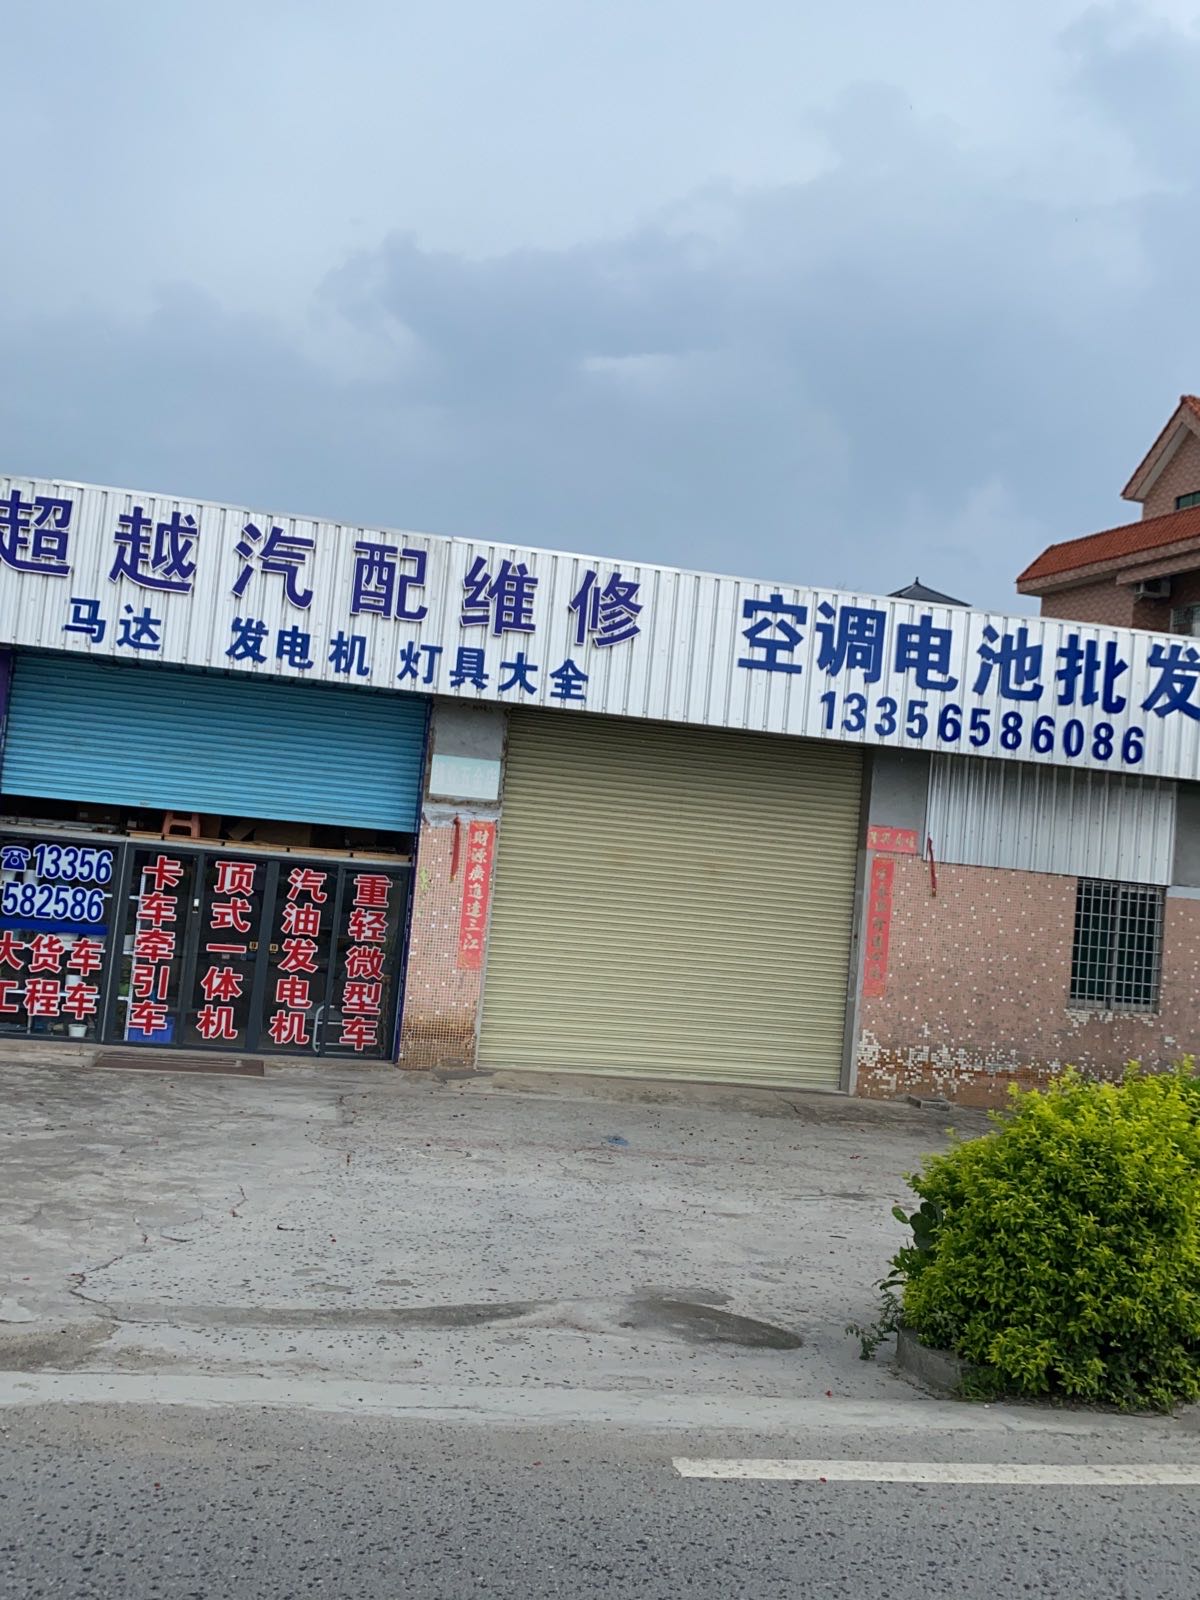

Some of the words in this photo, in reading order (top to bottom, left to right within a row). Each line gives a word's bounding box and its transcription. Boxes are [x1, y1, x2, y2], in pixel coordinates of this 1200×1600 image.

[0, 489, 643, 648] 超越汽配维修
[63, 597, 162, 652] 马达
[225, 616, 370, 677] 发电机
[397, 640, 589, 701] 灯具大全
[738, 594, 1200, 720] 空调电池批发
[821, 690, 1145, 765] 13356586086
[2, 881, 104, 922] 582586
[33, 843, 113, 884] 13356
[0, 930, 103, 976] 大货车
[128, 855, 183, 1035] 卡车牵引车
[196, 860, 256, 1039] 顶式一体机
[268, 867, 327, 1044] 汽油发电机
[339, 873, 392, 1051] 重轻微型车
